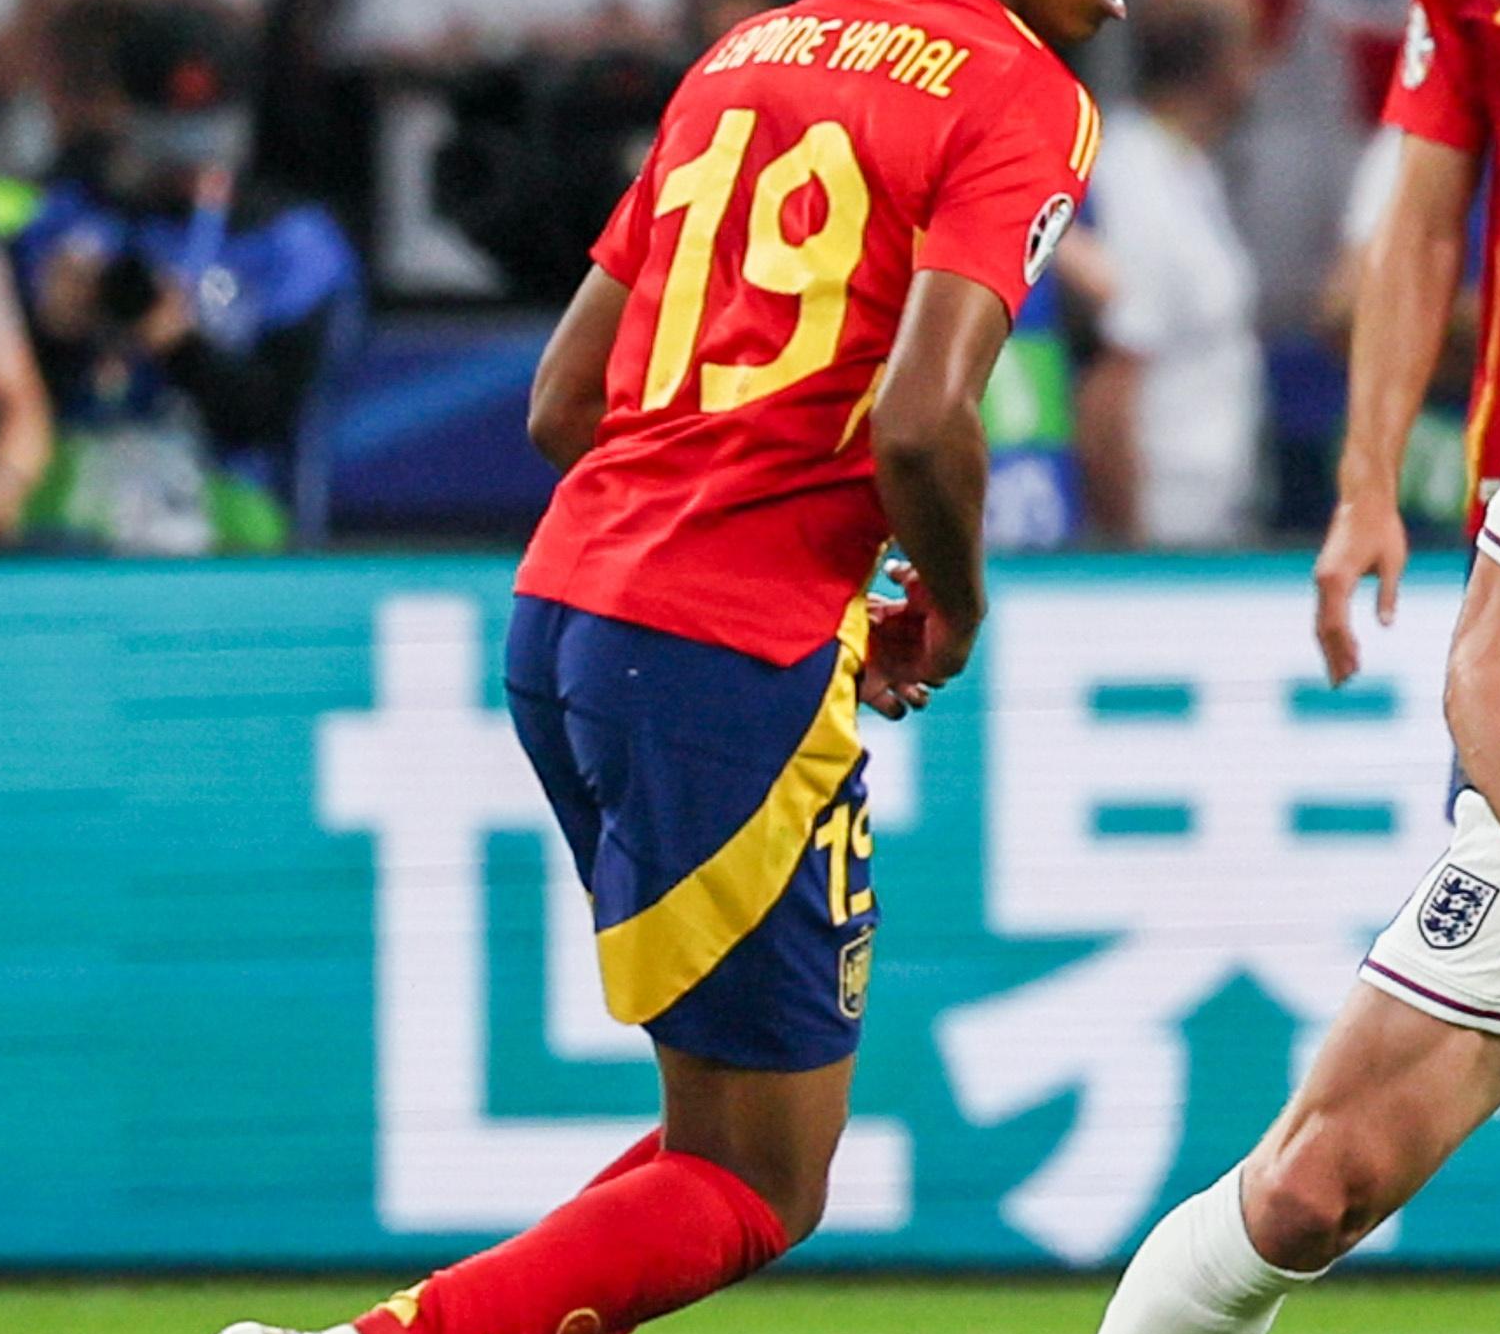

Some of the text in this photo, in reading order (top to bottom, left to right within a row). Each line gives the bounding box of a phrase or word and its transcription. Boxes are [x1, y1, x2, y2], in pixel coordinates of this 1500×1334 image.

[703, 17, 970, 97] LAMINE YAMAL
[641, 108, 871, 413] 19
